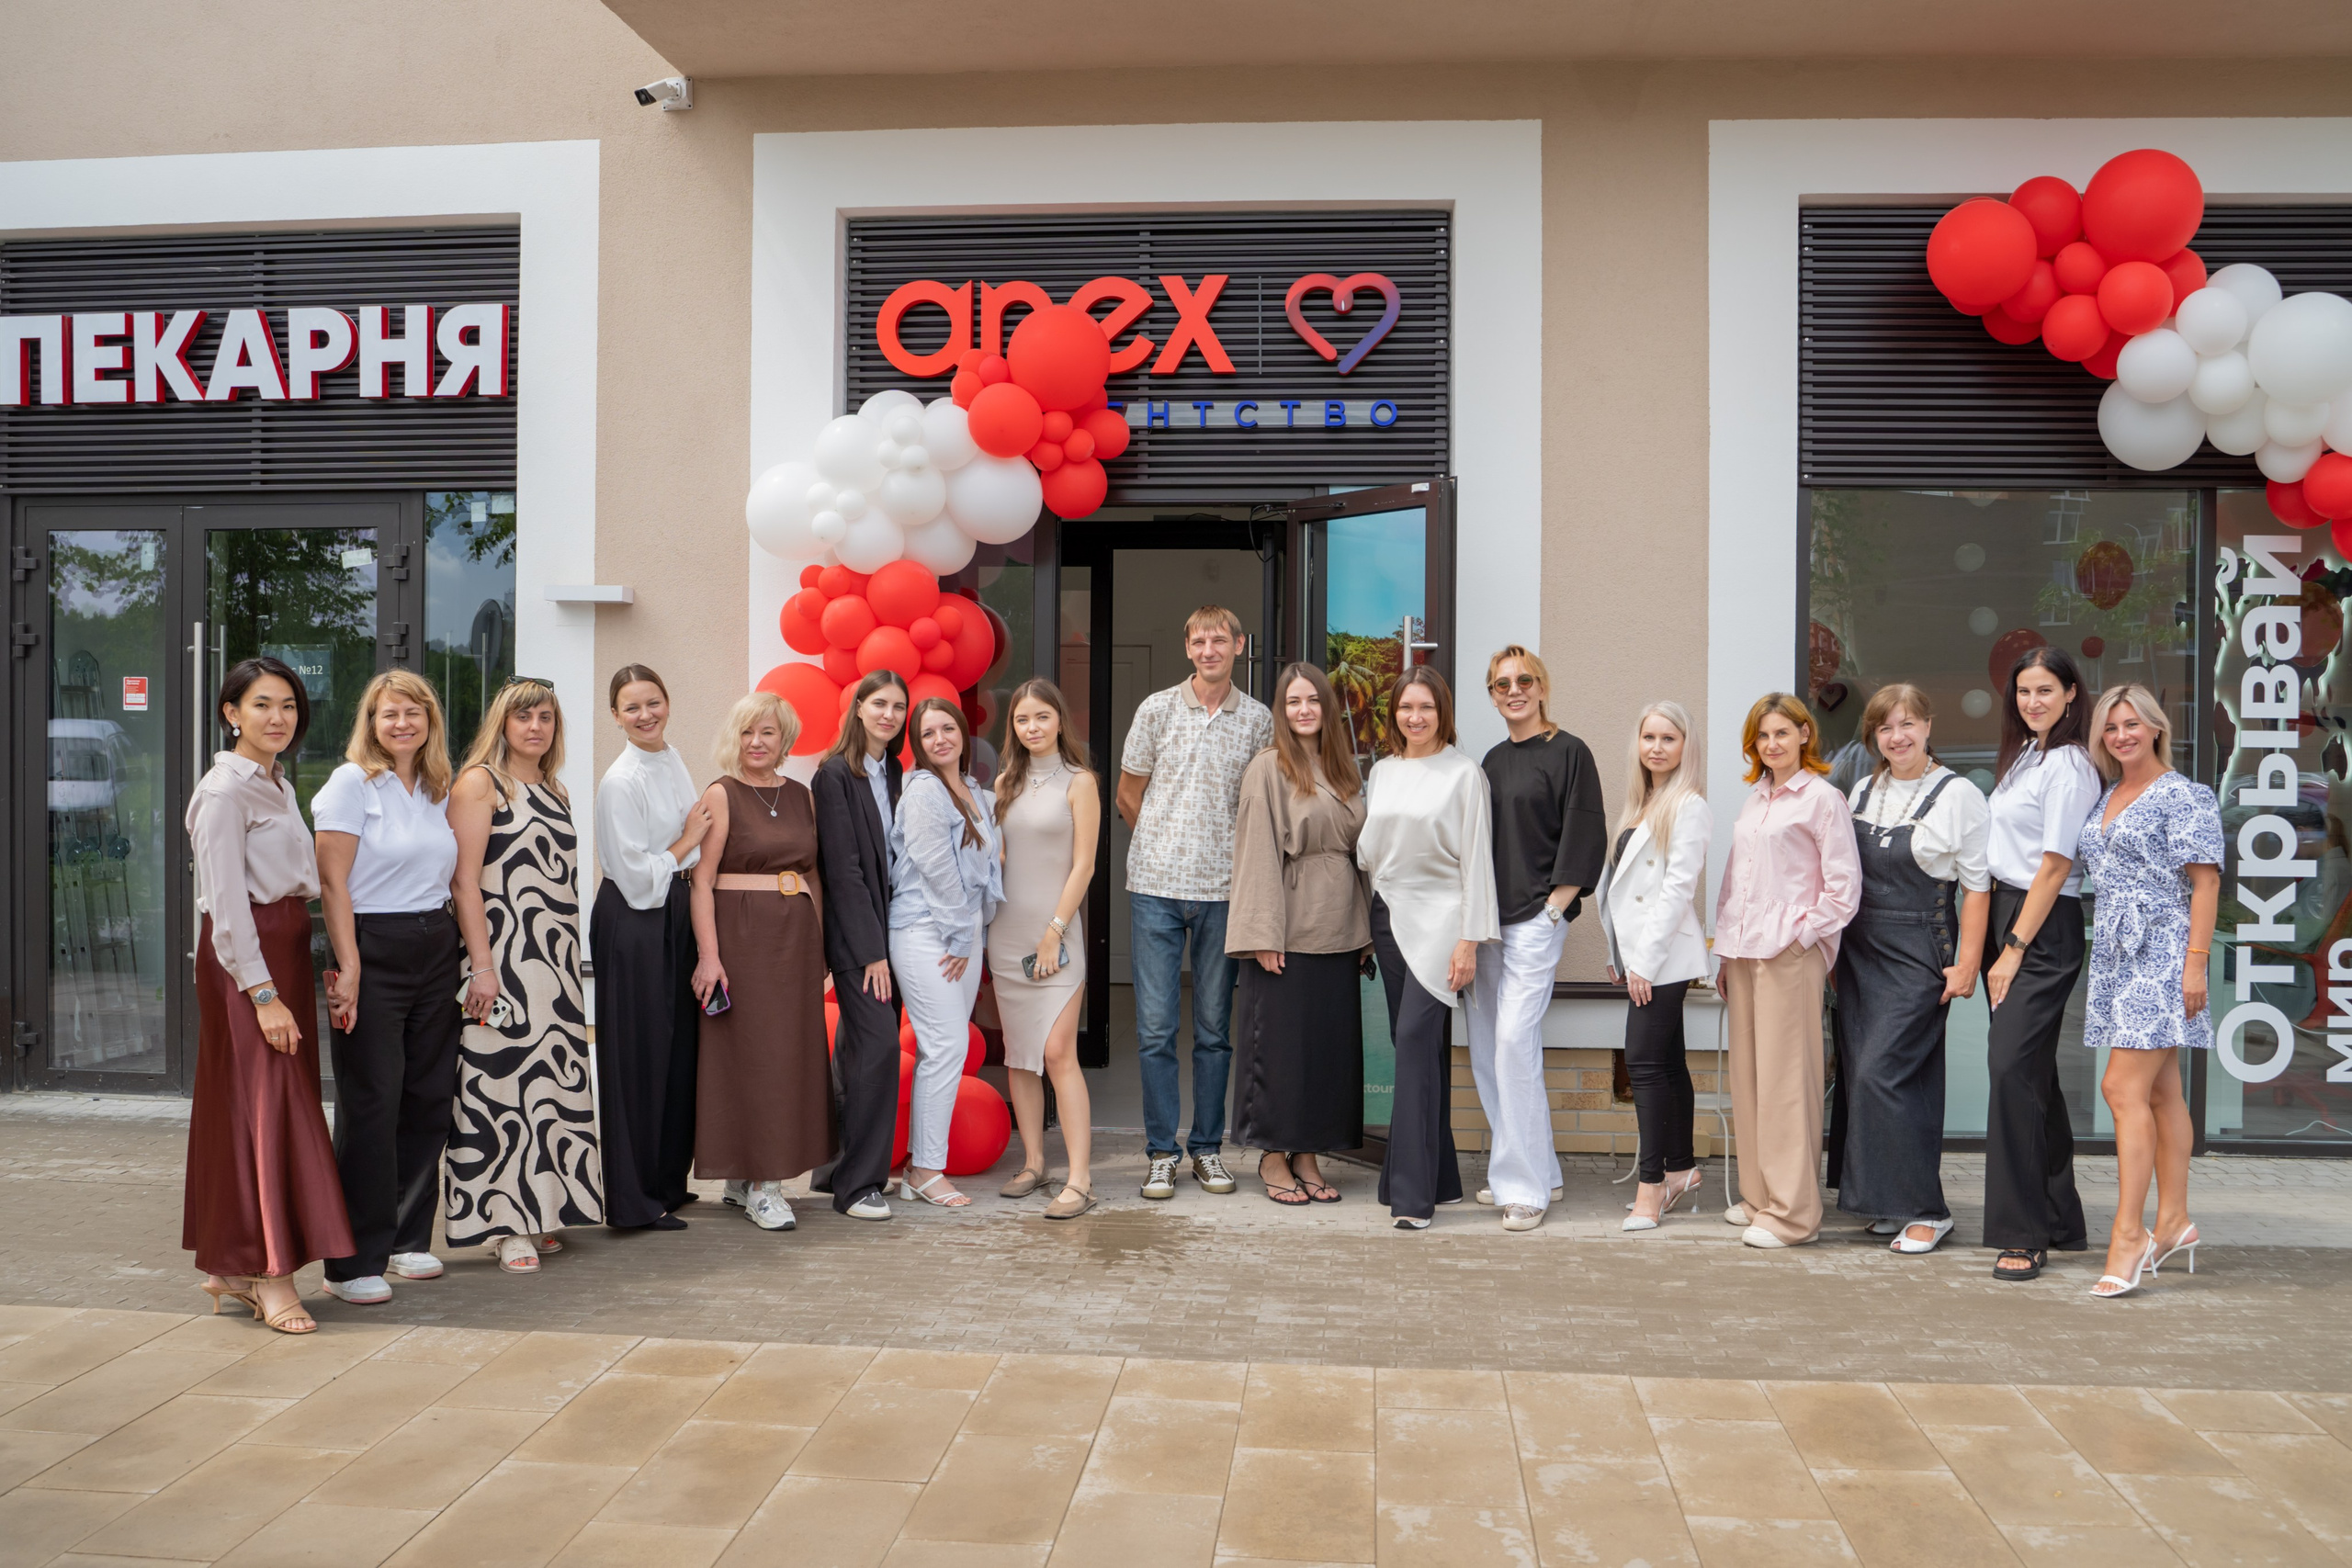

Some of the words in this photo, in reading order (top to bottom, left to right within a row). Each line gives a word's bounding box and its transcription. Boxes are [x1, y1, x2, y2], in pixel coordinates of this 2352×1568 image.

[0, 303, 510, 407] ПЕКАРНЯ
[1107, 399, 1398, 428] НТСТВО
[299, 665, 323, 675] №12
[2216, 535, 2316, 1083] Открывай
